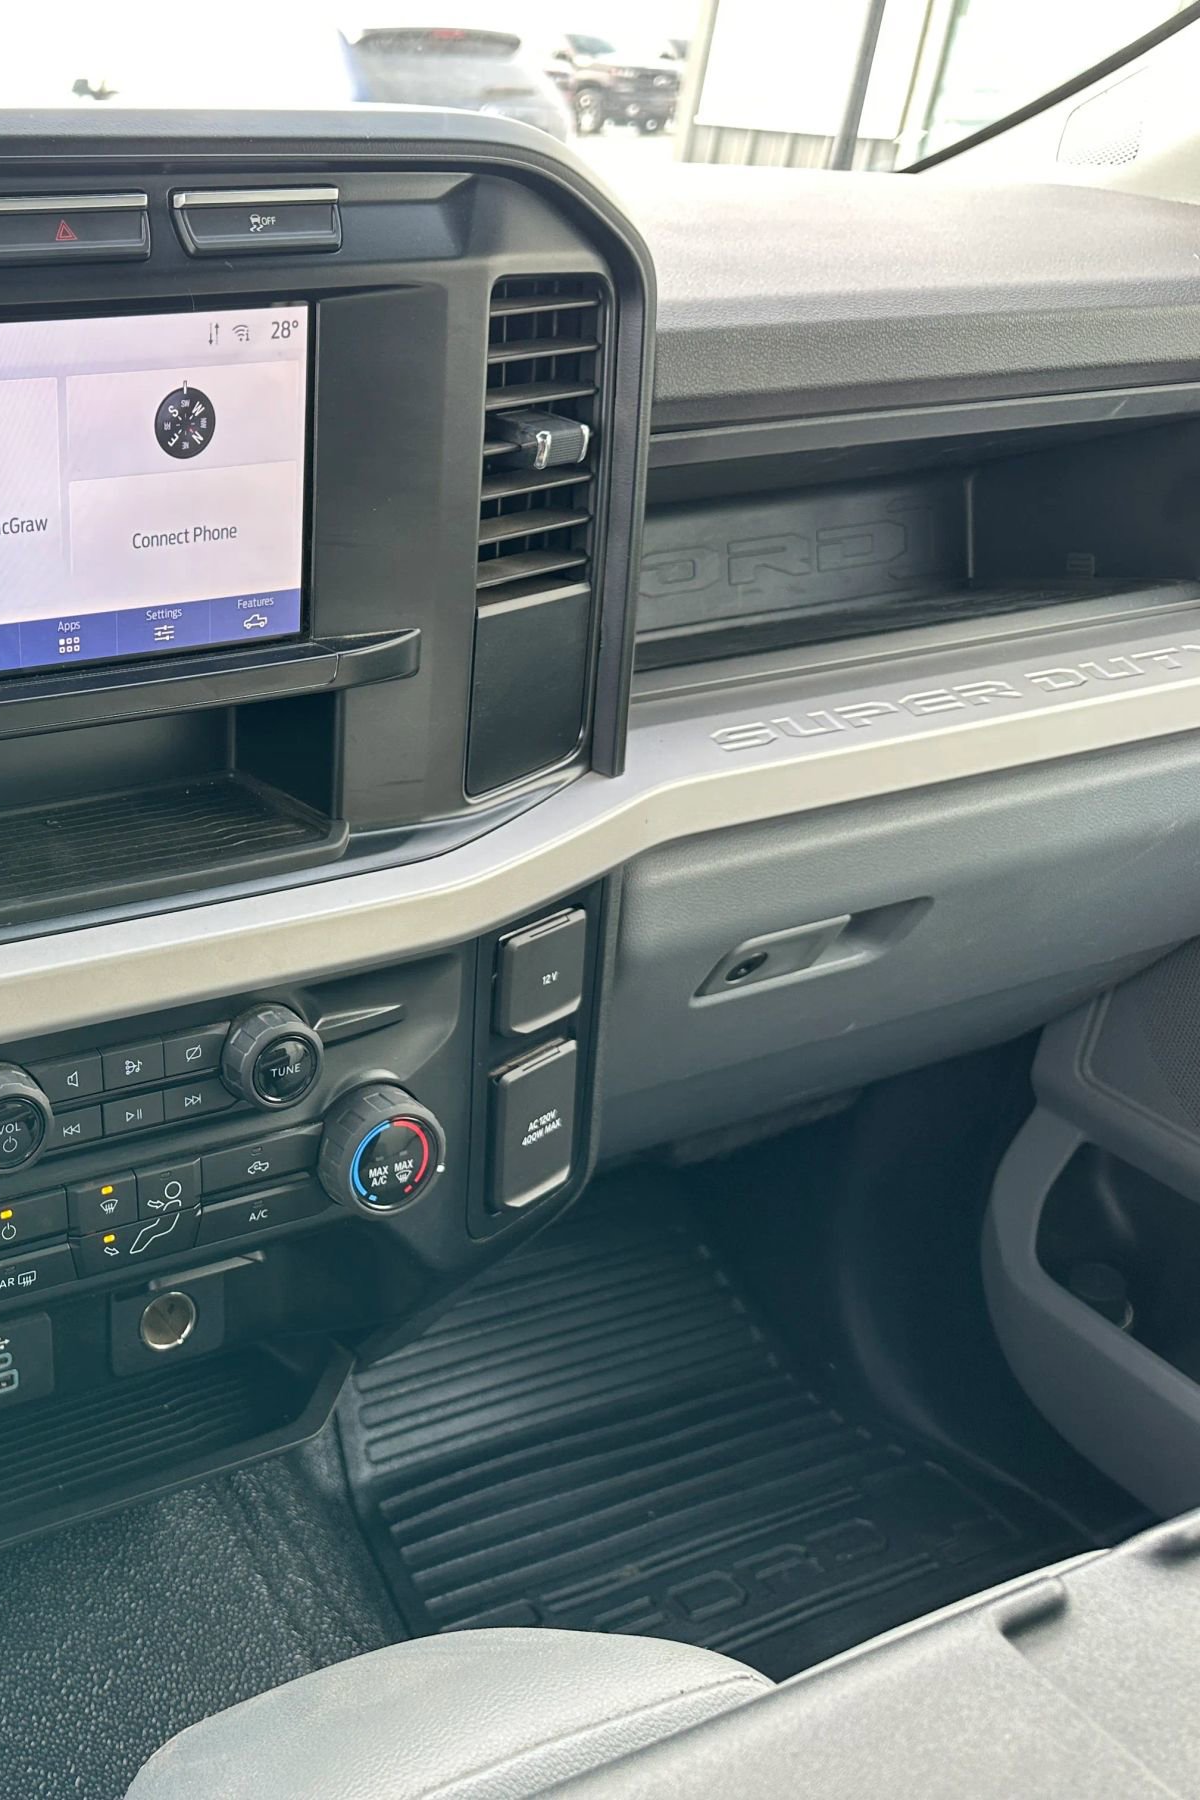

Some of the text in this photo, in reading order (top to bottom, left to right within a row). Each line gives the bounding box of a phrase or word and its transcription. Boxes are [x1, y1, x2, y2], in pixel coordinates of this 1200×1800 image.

[260, 215, 276, 226] OFF
[271, 319, 299, 340] 28°
[168, 405, 179, 418] S
[192, 401, 205, 417] W
[167, 433, 179, 447] E
[192, 431, 204, 445] N
[132, 525, 238, 549] Connect Phone
[638, 519, 907, 598] ORD
[237, 595, 275, 610] Features
[145, 606, 184, 622] Settings
[57, 620, 81, 635] Apps
[710, 644, 1200, 752] SUPER DUT
[271, 1063, 301, 1077] TUNE
[522, 1118, 562, 1146] 400W MAX
[528, 1120, 540, 1132] AC
[368, 1165, 389, 1179] MAX
[394, 1159, 414, 1172] MAX
[371, 1175, 388, 1187] A/C
[249, 1207, 269, 1222] A/C
